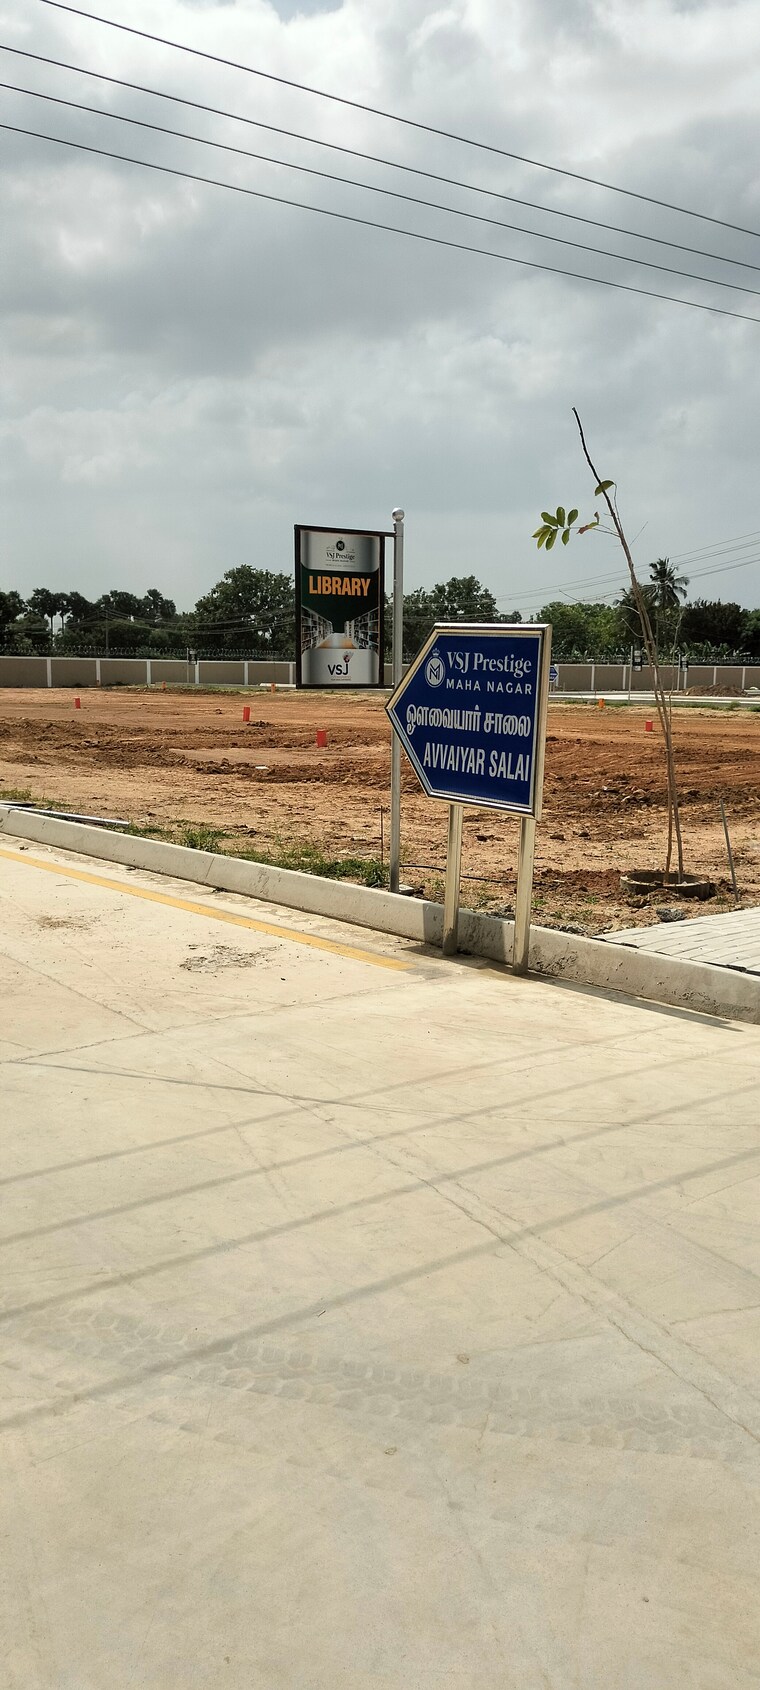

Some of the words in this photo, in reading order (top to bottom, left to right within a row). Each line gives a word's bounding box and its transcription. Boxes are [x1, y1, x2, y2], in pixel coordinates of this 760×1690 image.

[335, 552, 355, 560] Prestige
[309, 575, 371, 596] LIBRARY
[327, 663, 348, 675] VSJ
[447, 652, 470, 673] VSJ
[473, 652, 531, 678] Prestige
[446, 679, 481, 691] MAHA
[487, 681, 532, 695] NAGAR
[484, 712, 531, 737] சாலை
[423, 742, 485, 775] AVVAIYAR
[488, 750, 530, 782] SALAI
